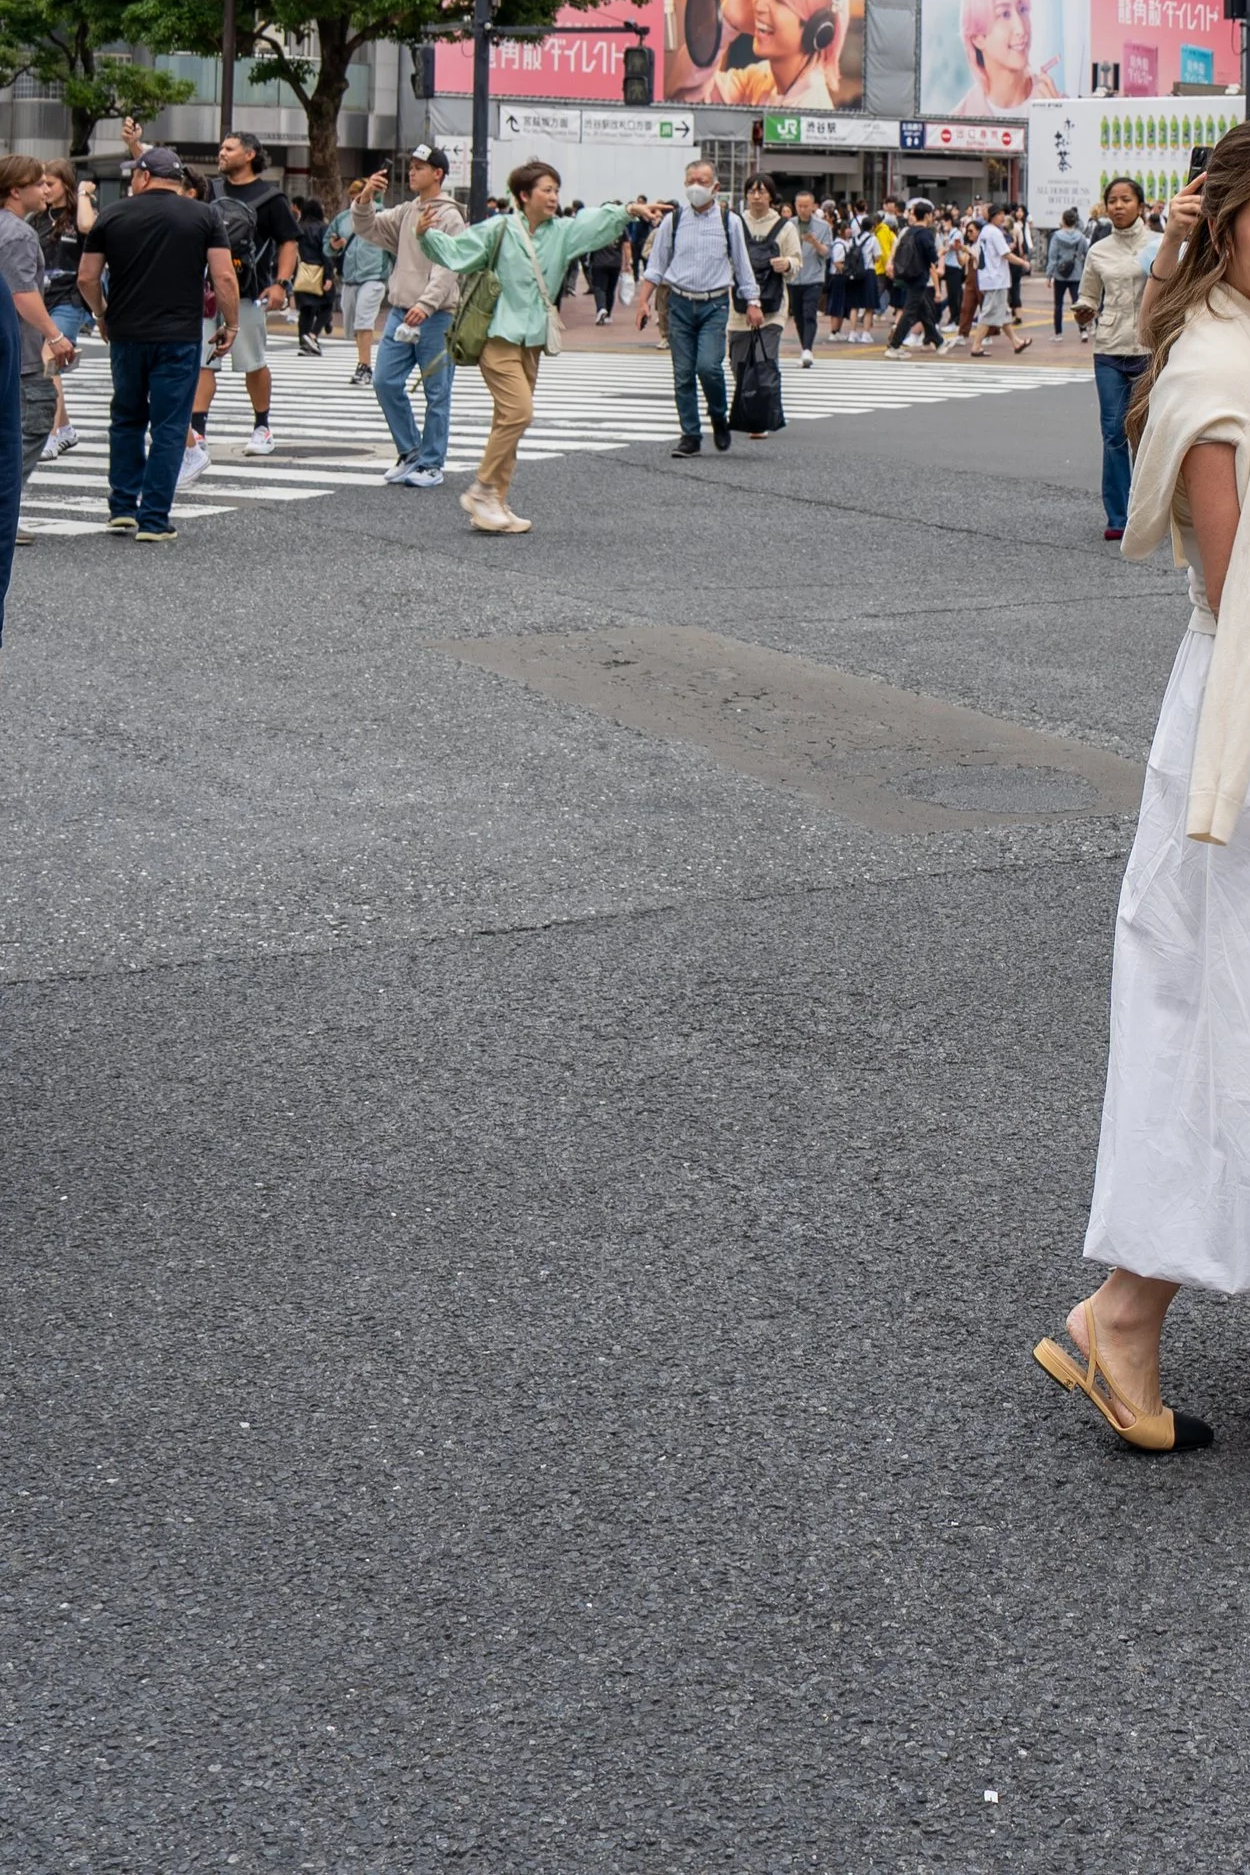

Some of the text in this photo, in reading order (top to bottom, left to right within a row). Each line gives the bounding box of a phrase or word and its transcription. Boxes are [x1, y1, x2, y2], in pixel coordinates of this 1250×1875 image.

[777, 119, 837, 135] JR 渋谷駅
[956, 129, 998, 140] 出口専用
